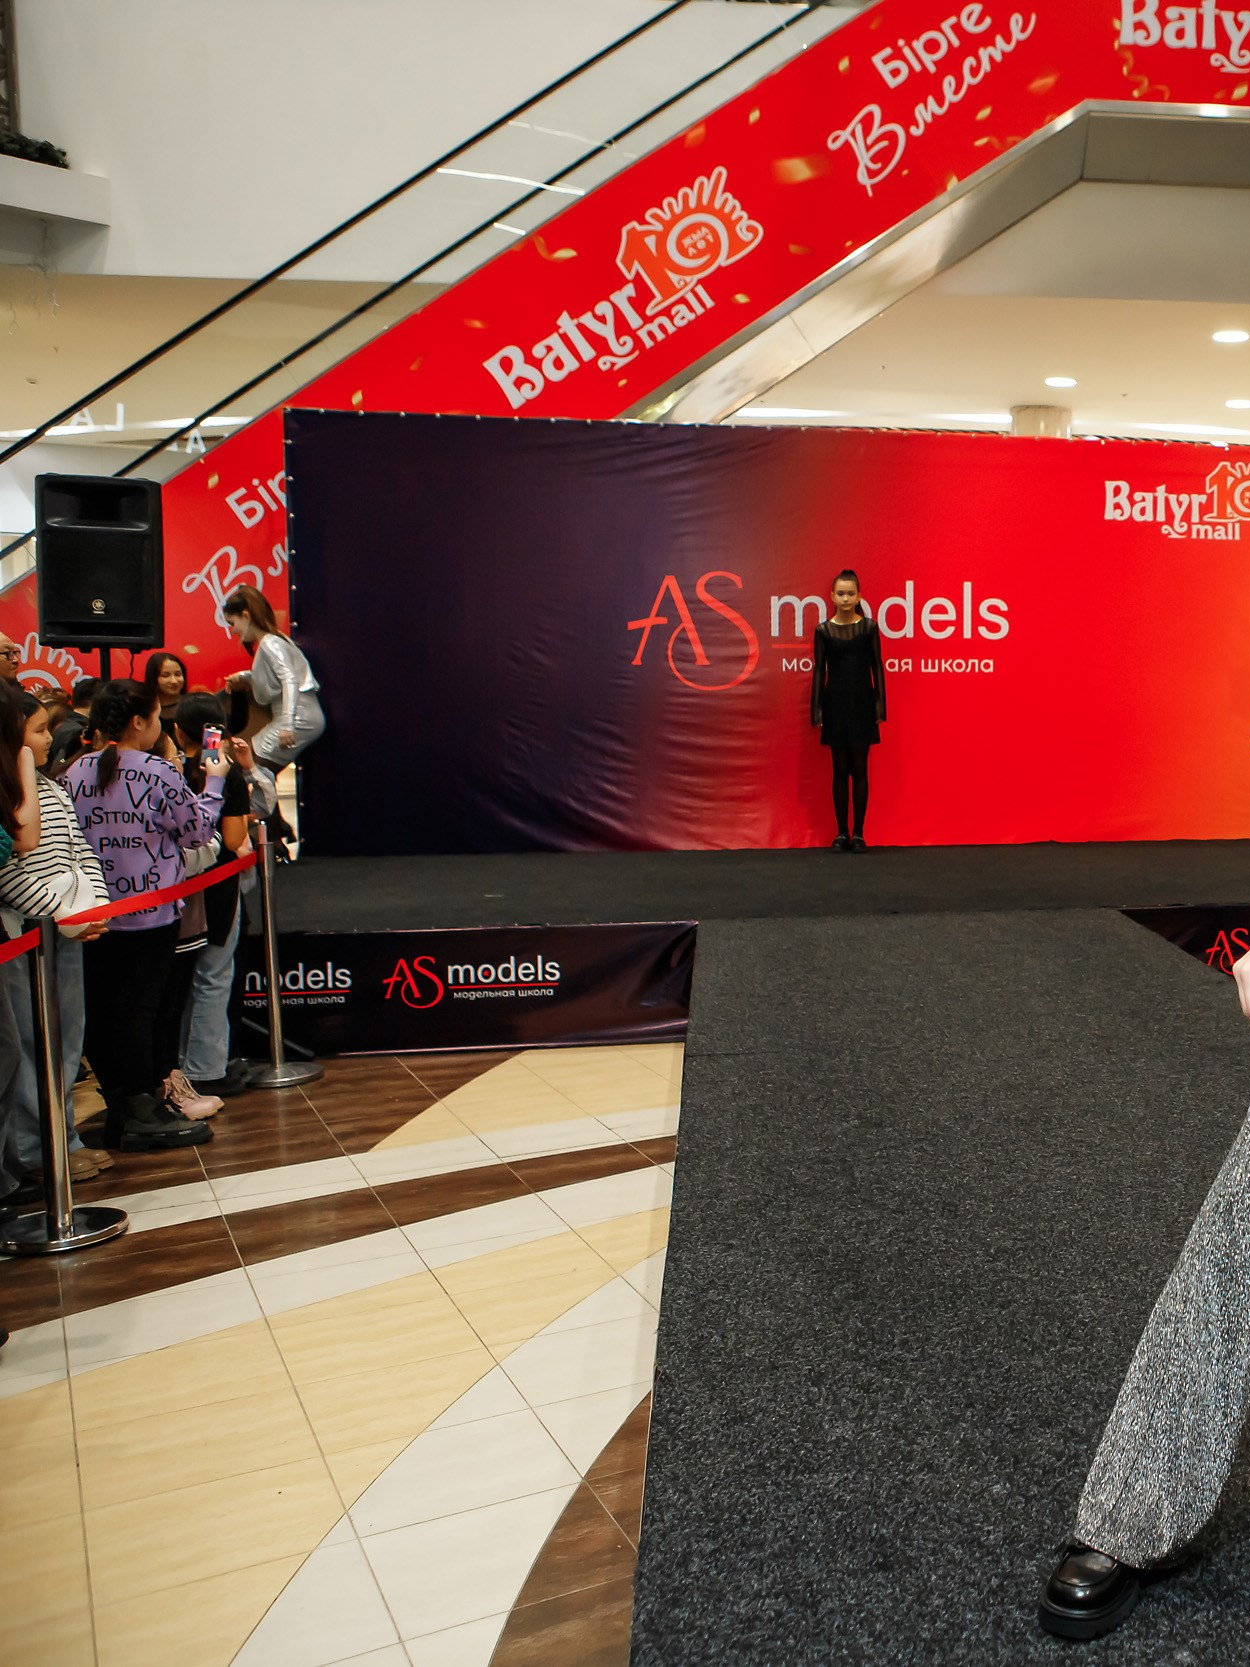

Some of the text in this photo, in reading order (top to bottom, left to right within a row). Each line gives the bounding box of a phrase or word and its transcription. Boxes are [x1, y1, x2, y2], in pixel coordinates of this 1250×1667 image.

[871, 3, 992, 89] Бірге
[827, 12, 1037, 197] Вместе
[636, 283, 715, 350] mall
[482, 283, 643, 410] Batyr
[1104, 480, 1207, 539] Batyr
[1191, 522, 1240, 540] mall
[627, 570, 1010, 691] AS mdels
[921, 658, 994, 673] школа
[307, 995, 346, 1006] школа
[383, 955, 561, 1009] AS models
[453, 987, 554, 1001] модельная школа
